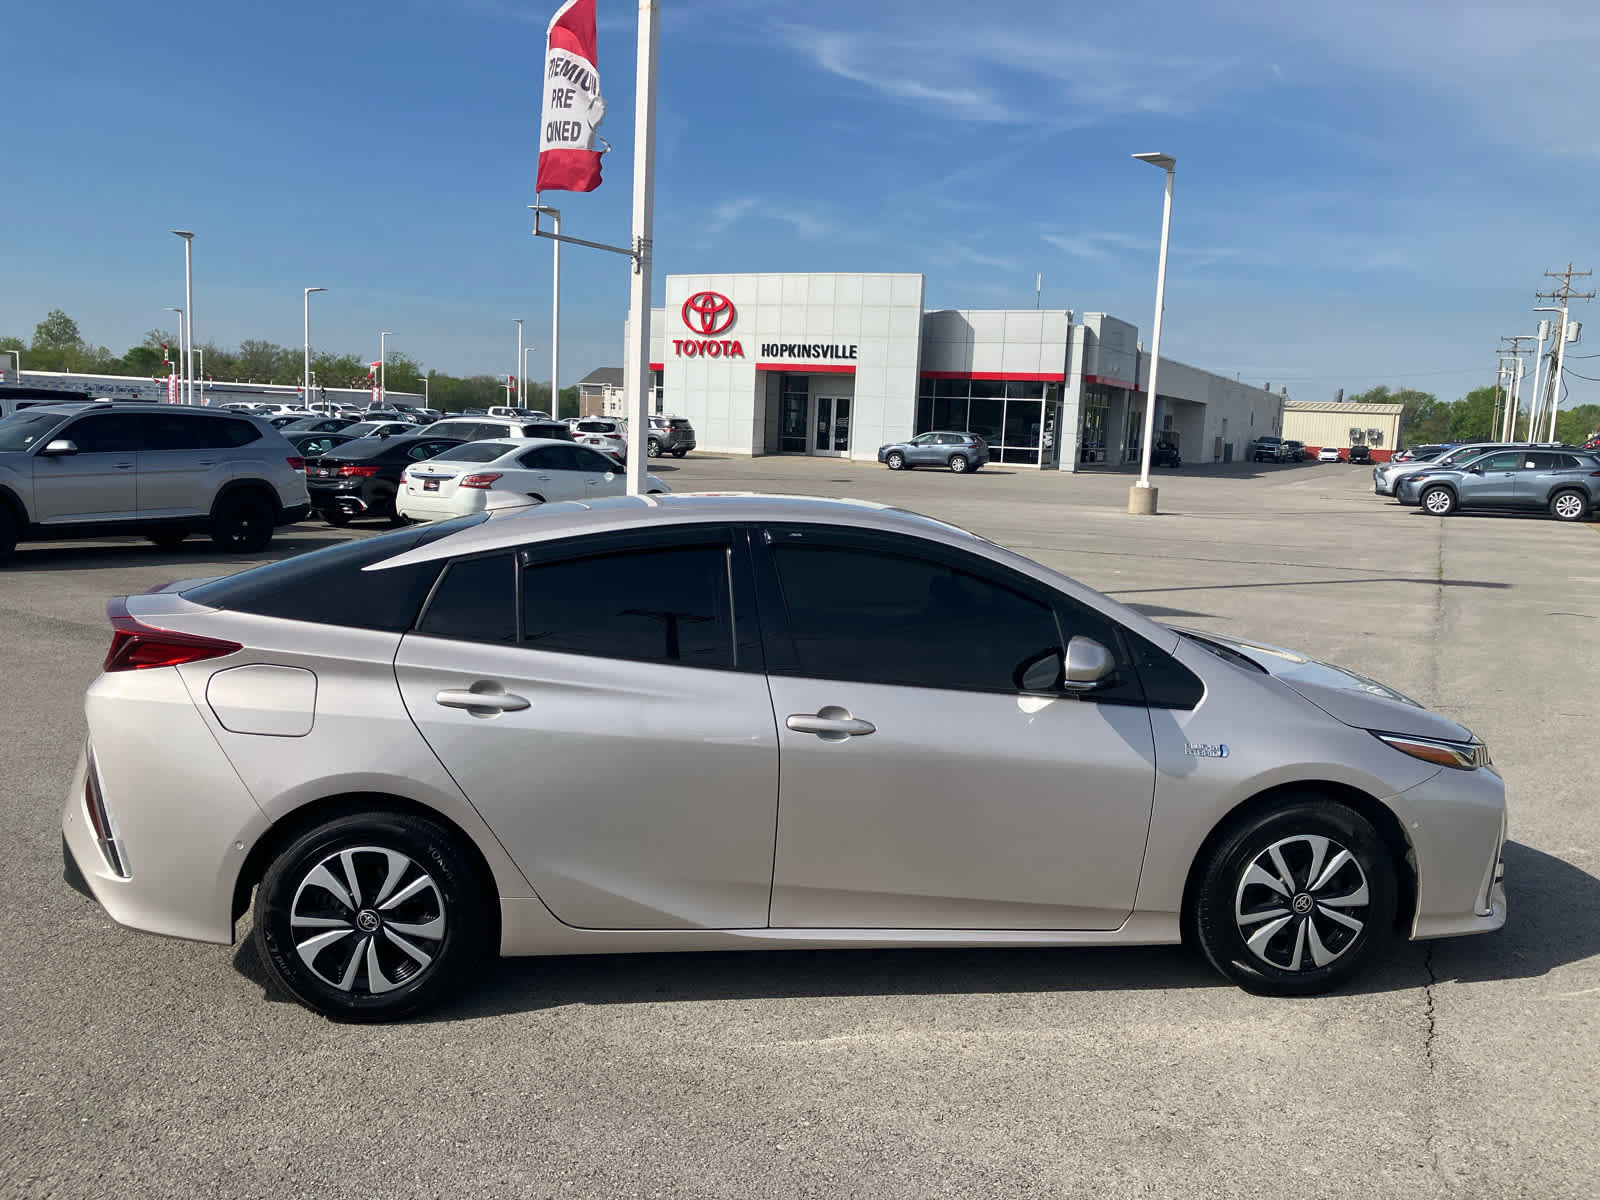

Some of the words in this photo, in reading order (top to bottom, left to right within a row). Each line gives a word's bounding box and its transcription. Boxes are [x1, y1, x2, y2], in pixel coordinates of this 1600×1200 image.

[551, 88, 576, 109] PRE
[672, 339, 745, 358] TOYOTA
[761, 343, 858, 360] HOPKINSVILLE
